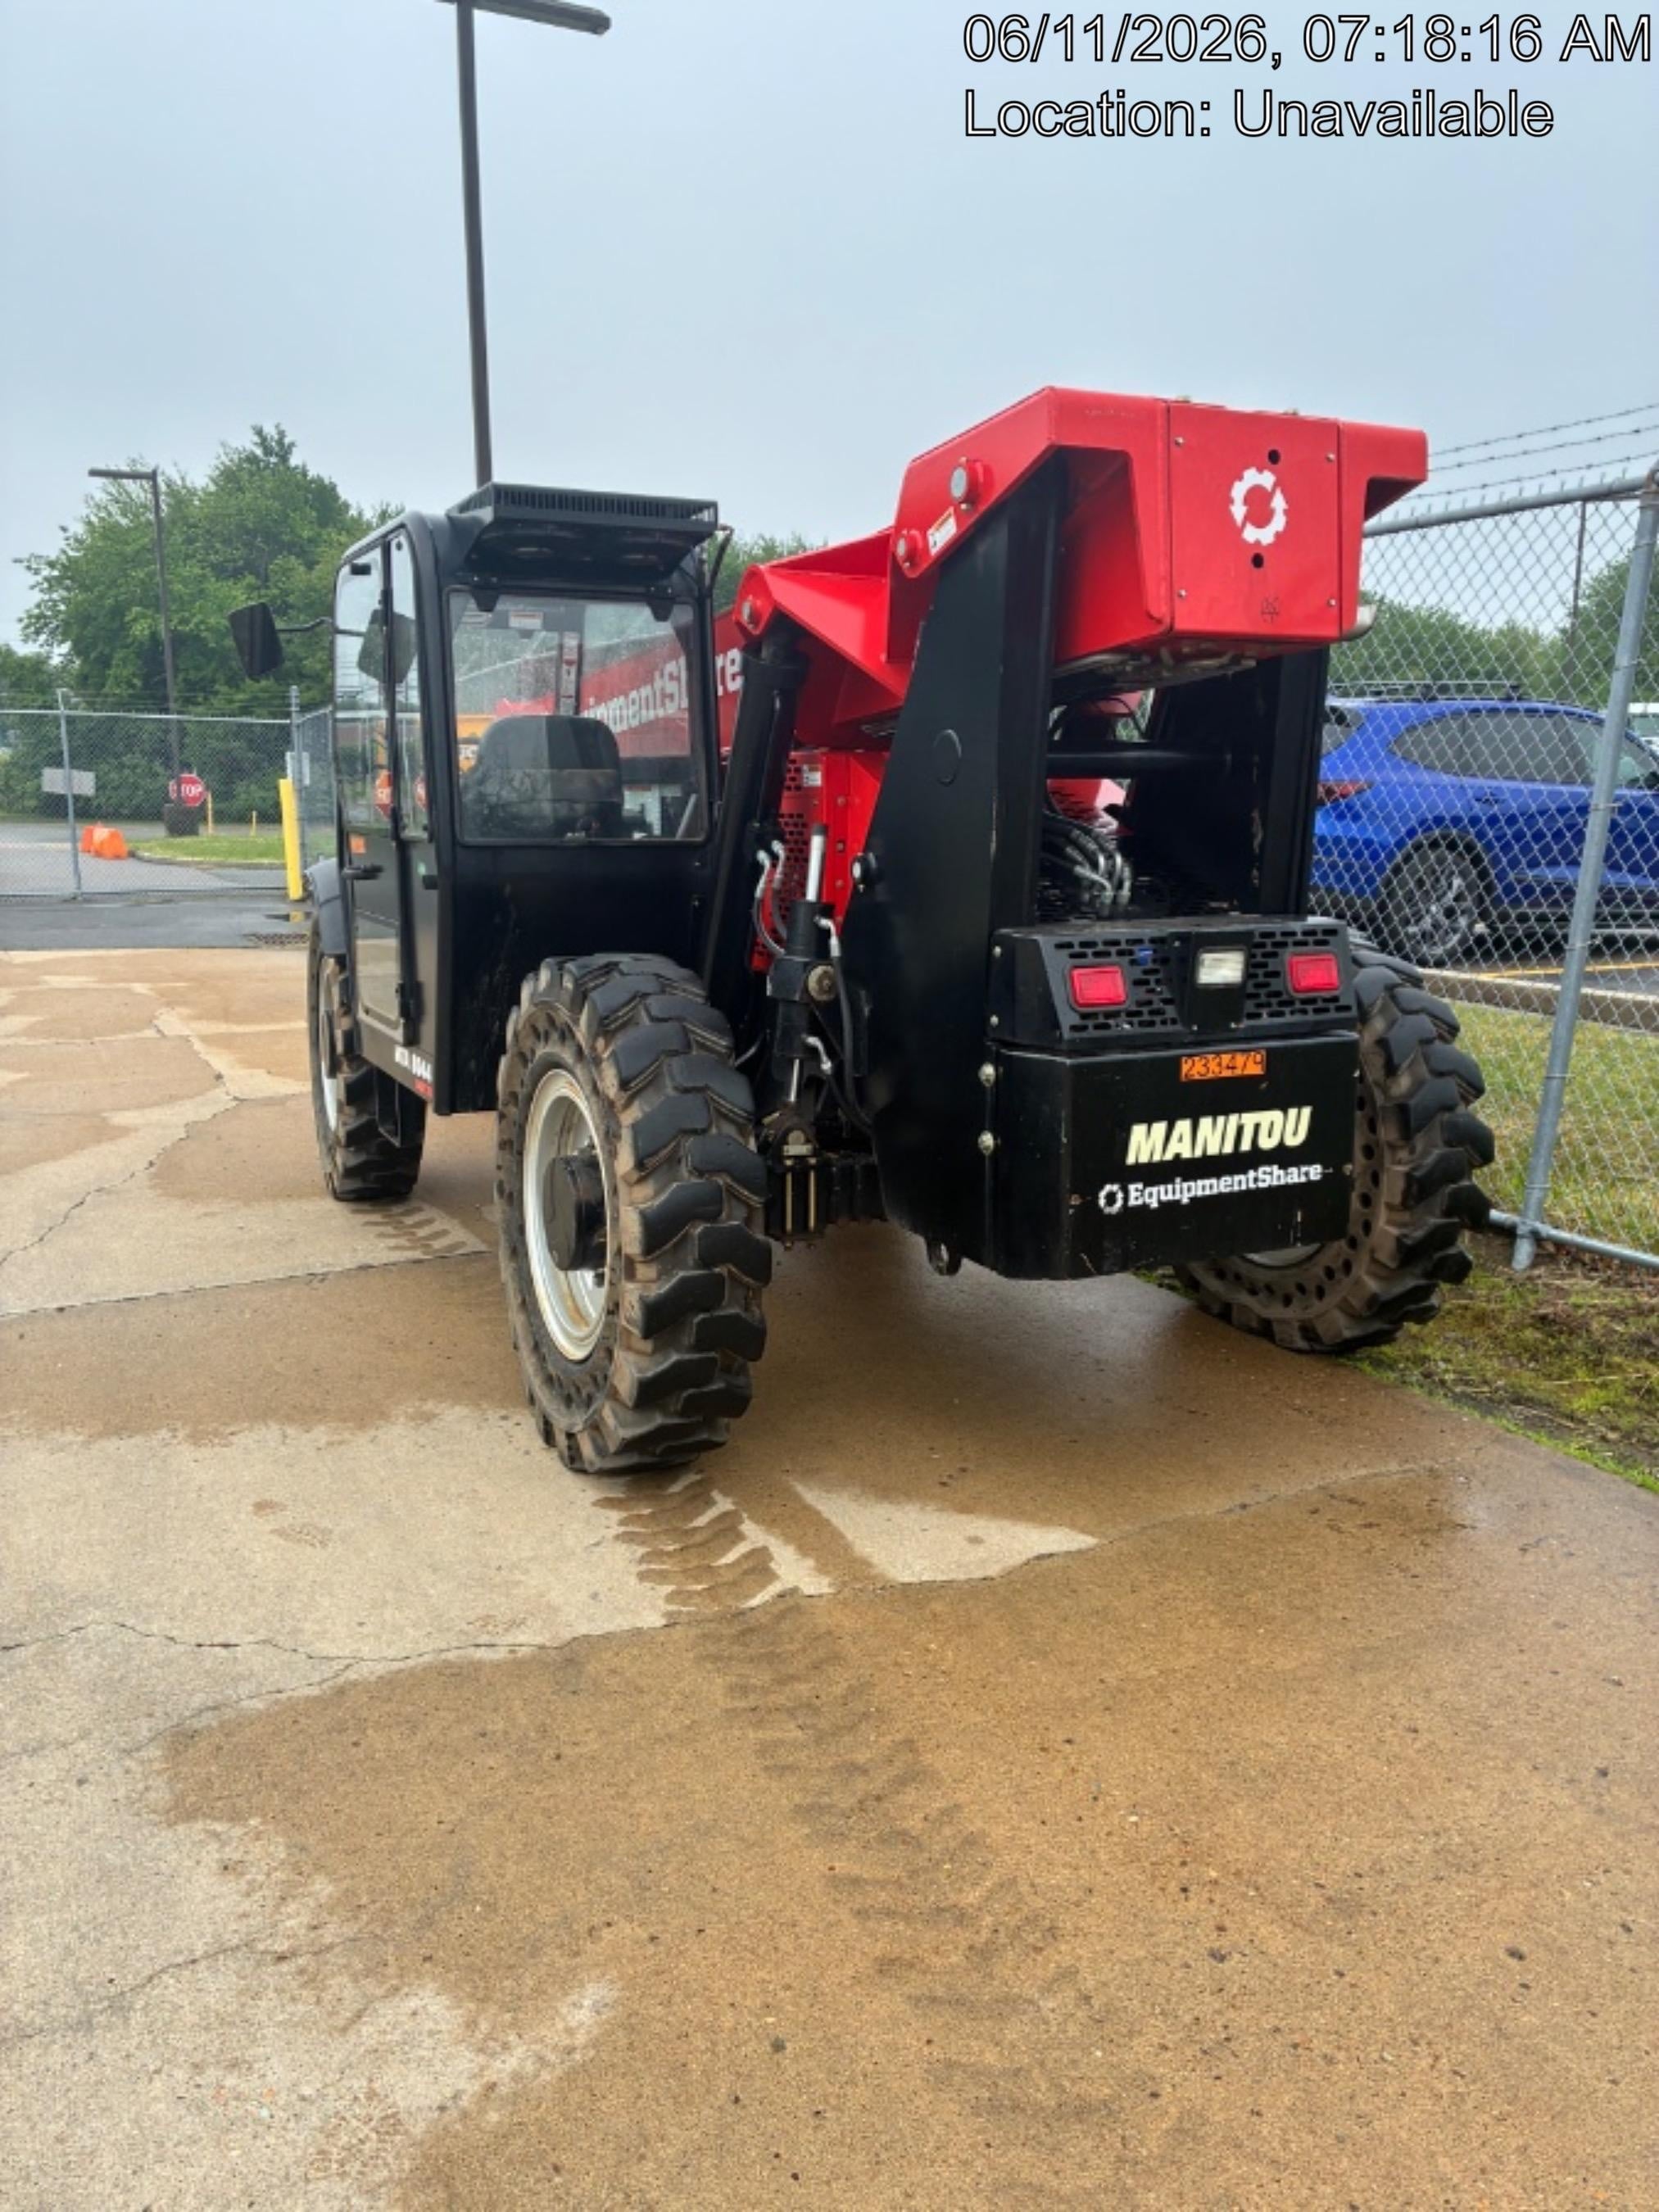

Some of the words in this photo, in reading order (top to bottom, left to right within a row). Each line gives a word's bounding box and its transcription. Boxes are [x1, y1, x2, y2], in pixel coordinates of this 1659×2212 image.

[1183, 1052, 1264, 1079] 233479
[1126, 1106, 1312, 1166] MANITOU
[1127, 1164, 1323, 1208] EquipmentShare
